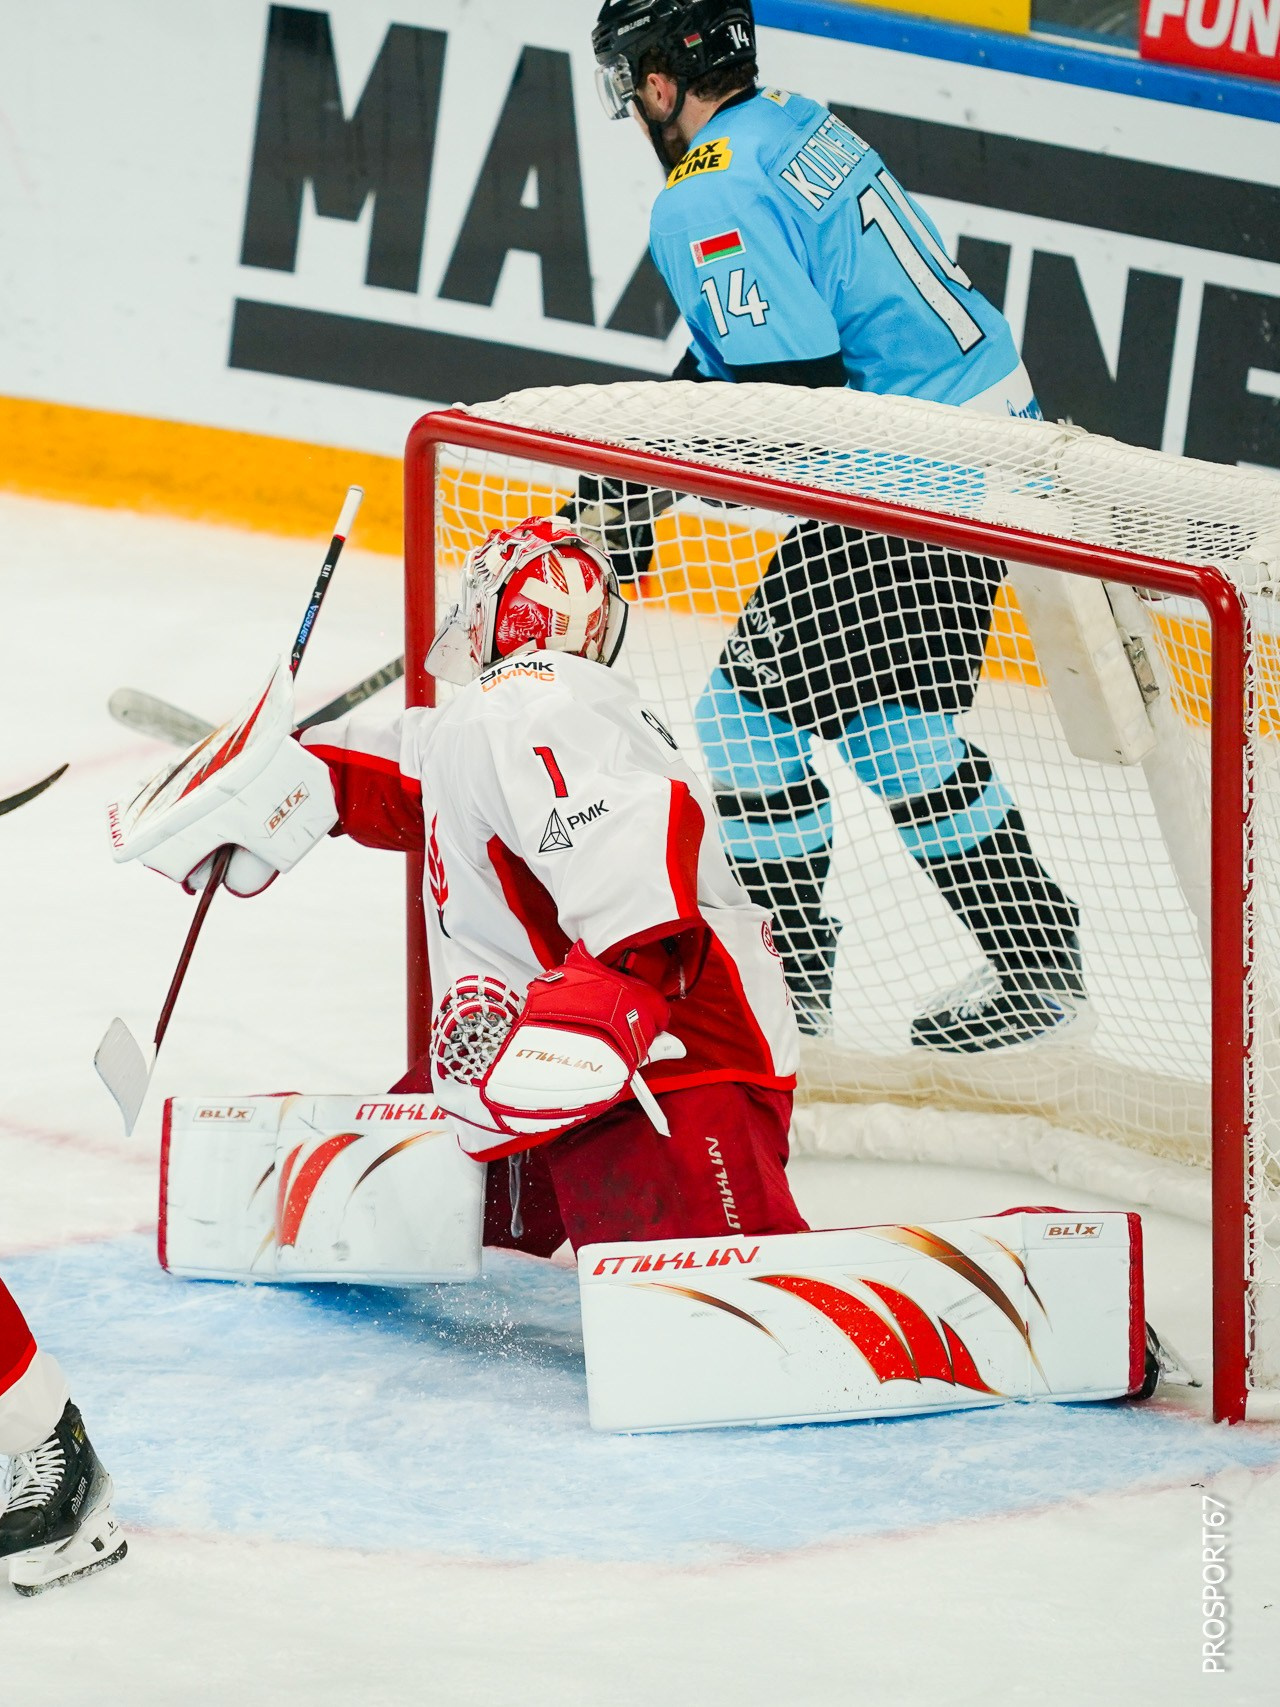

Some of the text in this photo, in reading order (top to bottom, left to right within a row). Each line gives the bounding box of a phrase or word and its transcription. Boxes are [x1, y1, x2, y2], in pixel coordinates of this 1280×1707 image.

[728, 24, 750, 49] 14
[673, 153, 722, 182] LINE
[675, 141, 720, 171] MAX
[240, 4, 678, 340] MA
[701, 268, 769, 338] 14
[481, 668, 556, 693] UMMC
[532, 746, 569, 799] 1
[269, 788, 305, 830] BLIX
[199, 1107, 249, 1119] BLIX
[1047, 1223, 1098, 1237] BLIX
[592, 1246, 761, 1276] MIKLIN
[70, 1476, 89, 1516] BAUER
